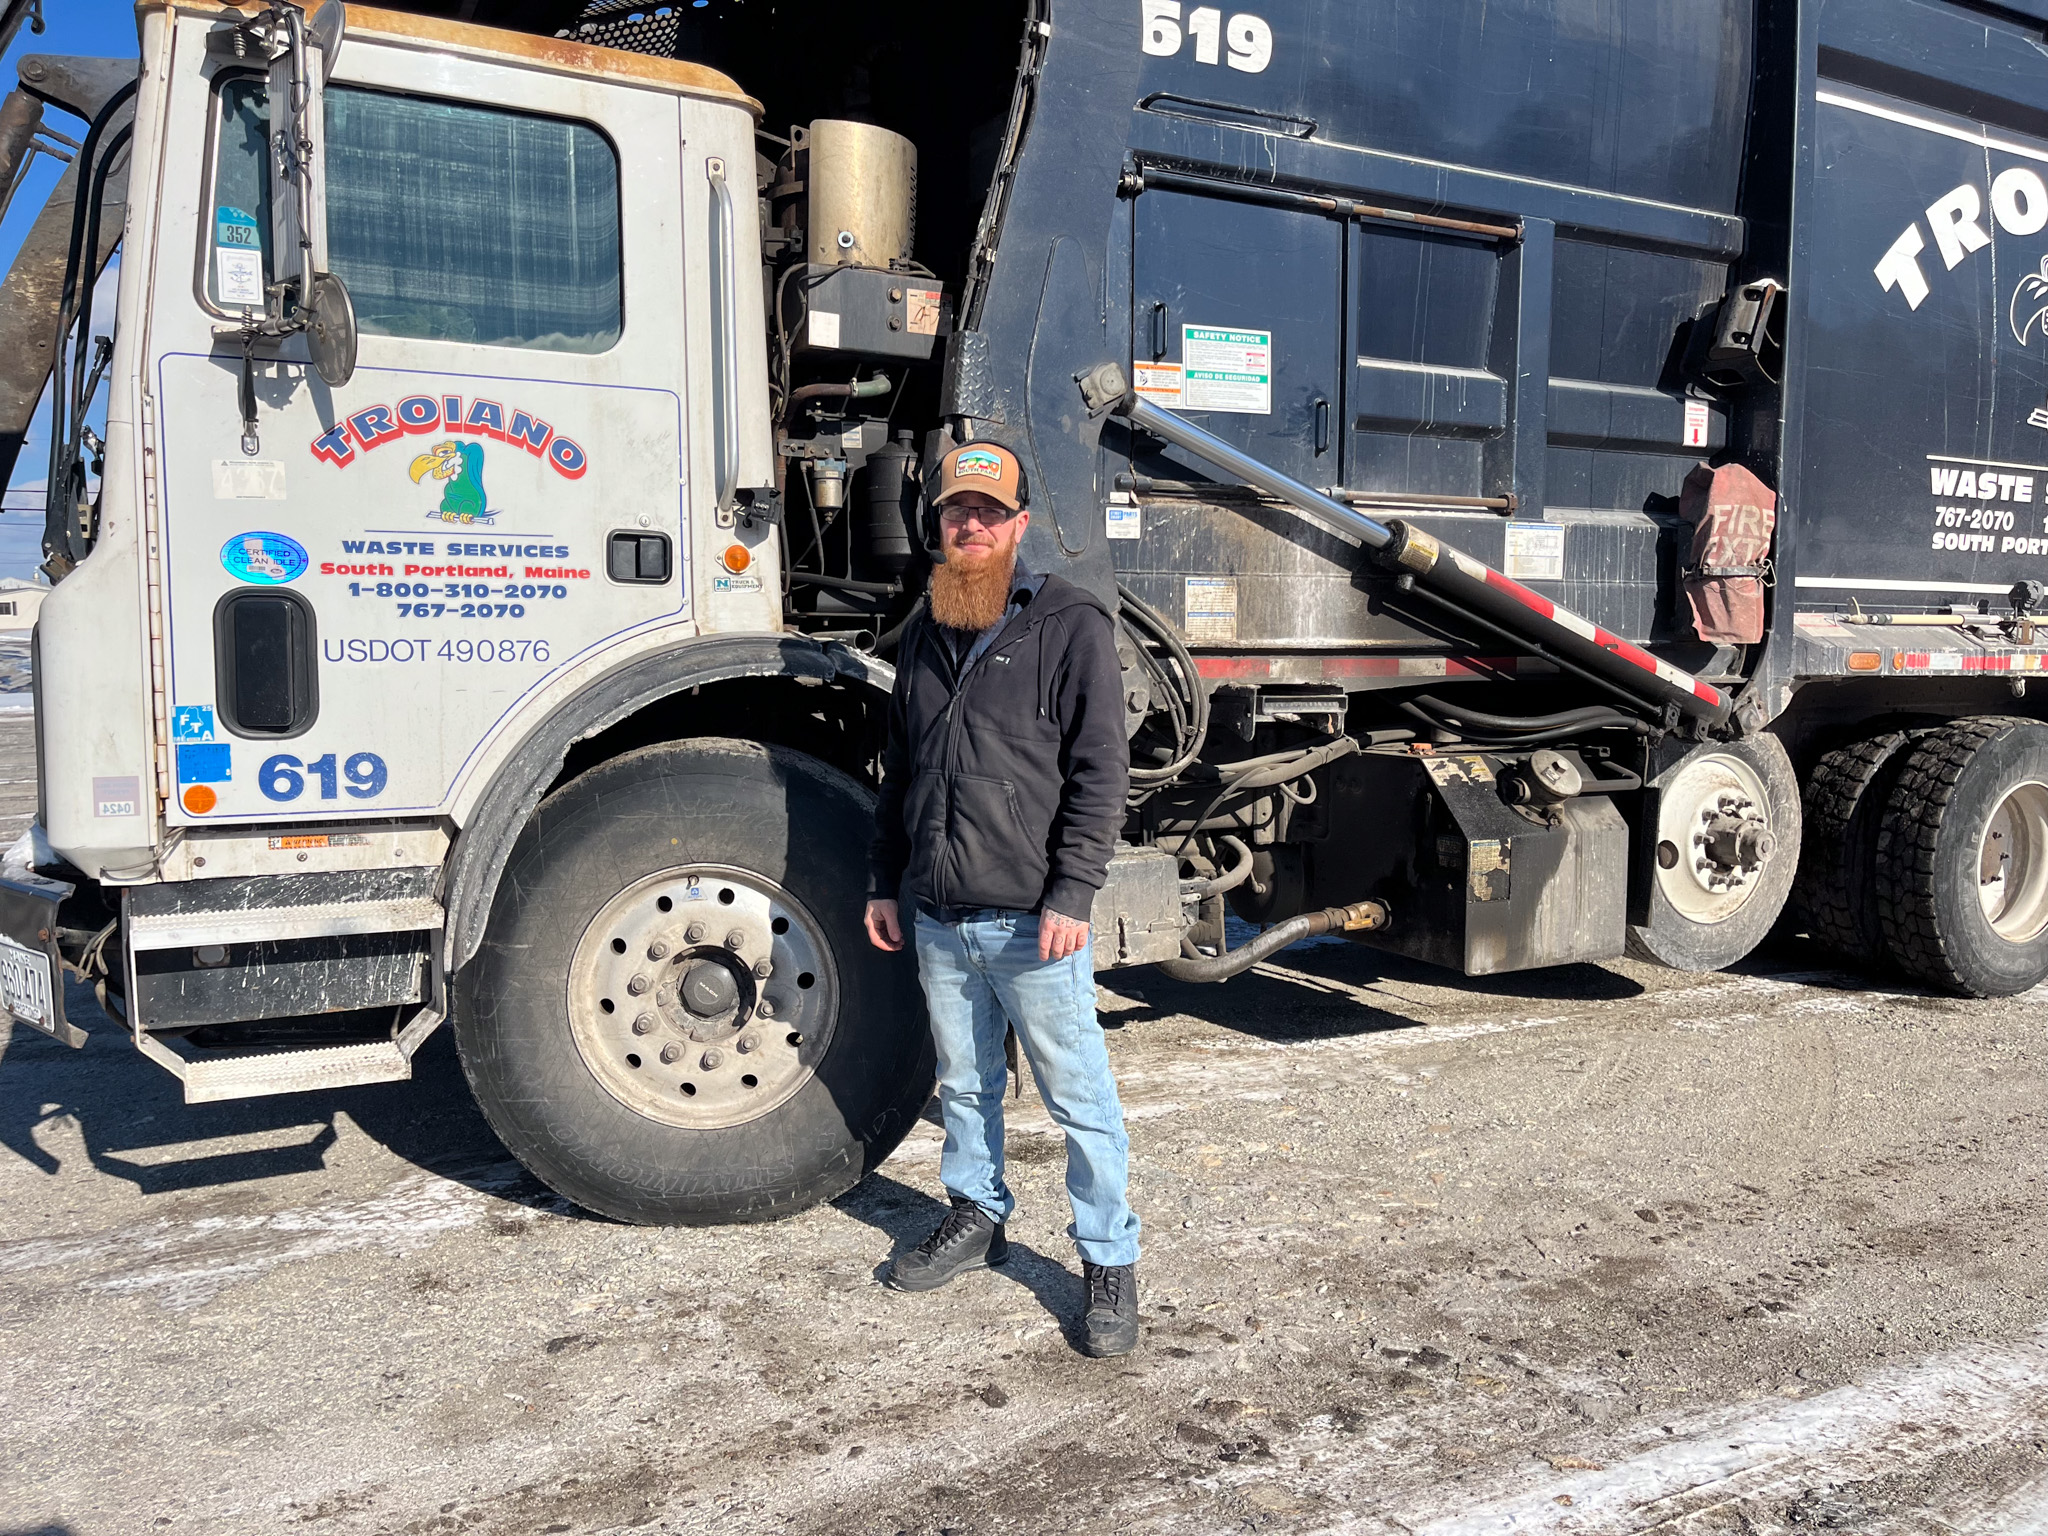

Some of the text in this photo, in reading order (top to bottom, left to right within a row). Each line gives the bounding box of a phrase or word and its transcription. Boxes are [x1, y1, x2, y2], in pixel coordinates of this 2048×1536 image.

[1140, 0, 1273, 74] 619
[226, 225, 252, 245] 352
[1873, 167, 2048, 312] TRO
[1193, 331, 1261, 343] SAFETY NOTICE
[1193, 372, 1214, 380] AVISO
[1225, 374, 1261, 383] SEGURIDAD
[311, 394, 588, 481] TROIANO
[980, 469, 997, 477] PARK
[1930, 467, 2034, 503] WASTE
[1714, 504, 1775, 540] FIRE
[1935, 506, 2015, 531] 767-2070
[341, 540, 570, 559] WASTE SERVICES
[1931, 531, 1996, 553] SOUTH
[233, 556, 296, 566] CLEAN IDLE
[238, 548, 291, 557] CERTIFIED
[320, 562, 591, 580] South Portland, Maine
[348, 582, 568, 599] 1-800-310-2070
[397, 602, 525, 619] 767-2070
[324, 638, 551, 663] USDOT 490876
[258, 751, 389, 803] 619
[699, 981, 719, 998] MACK
